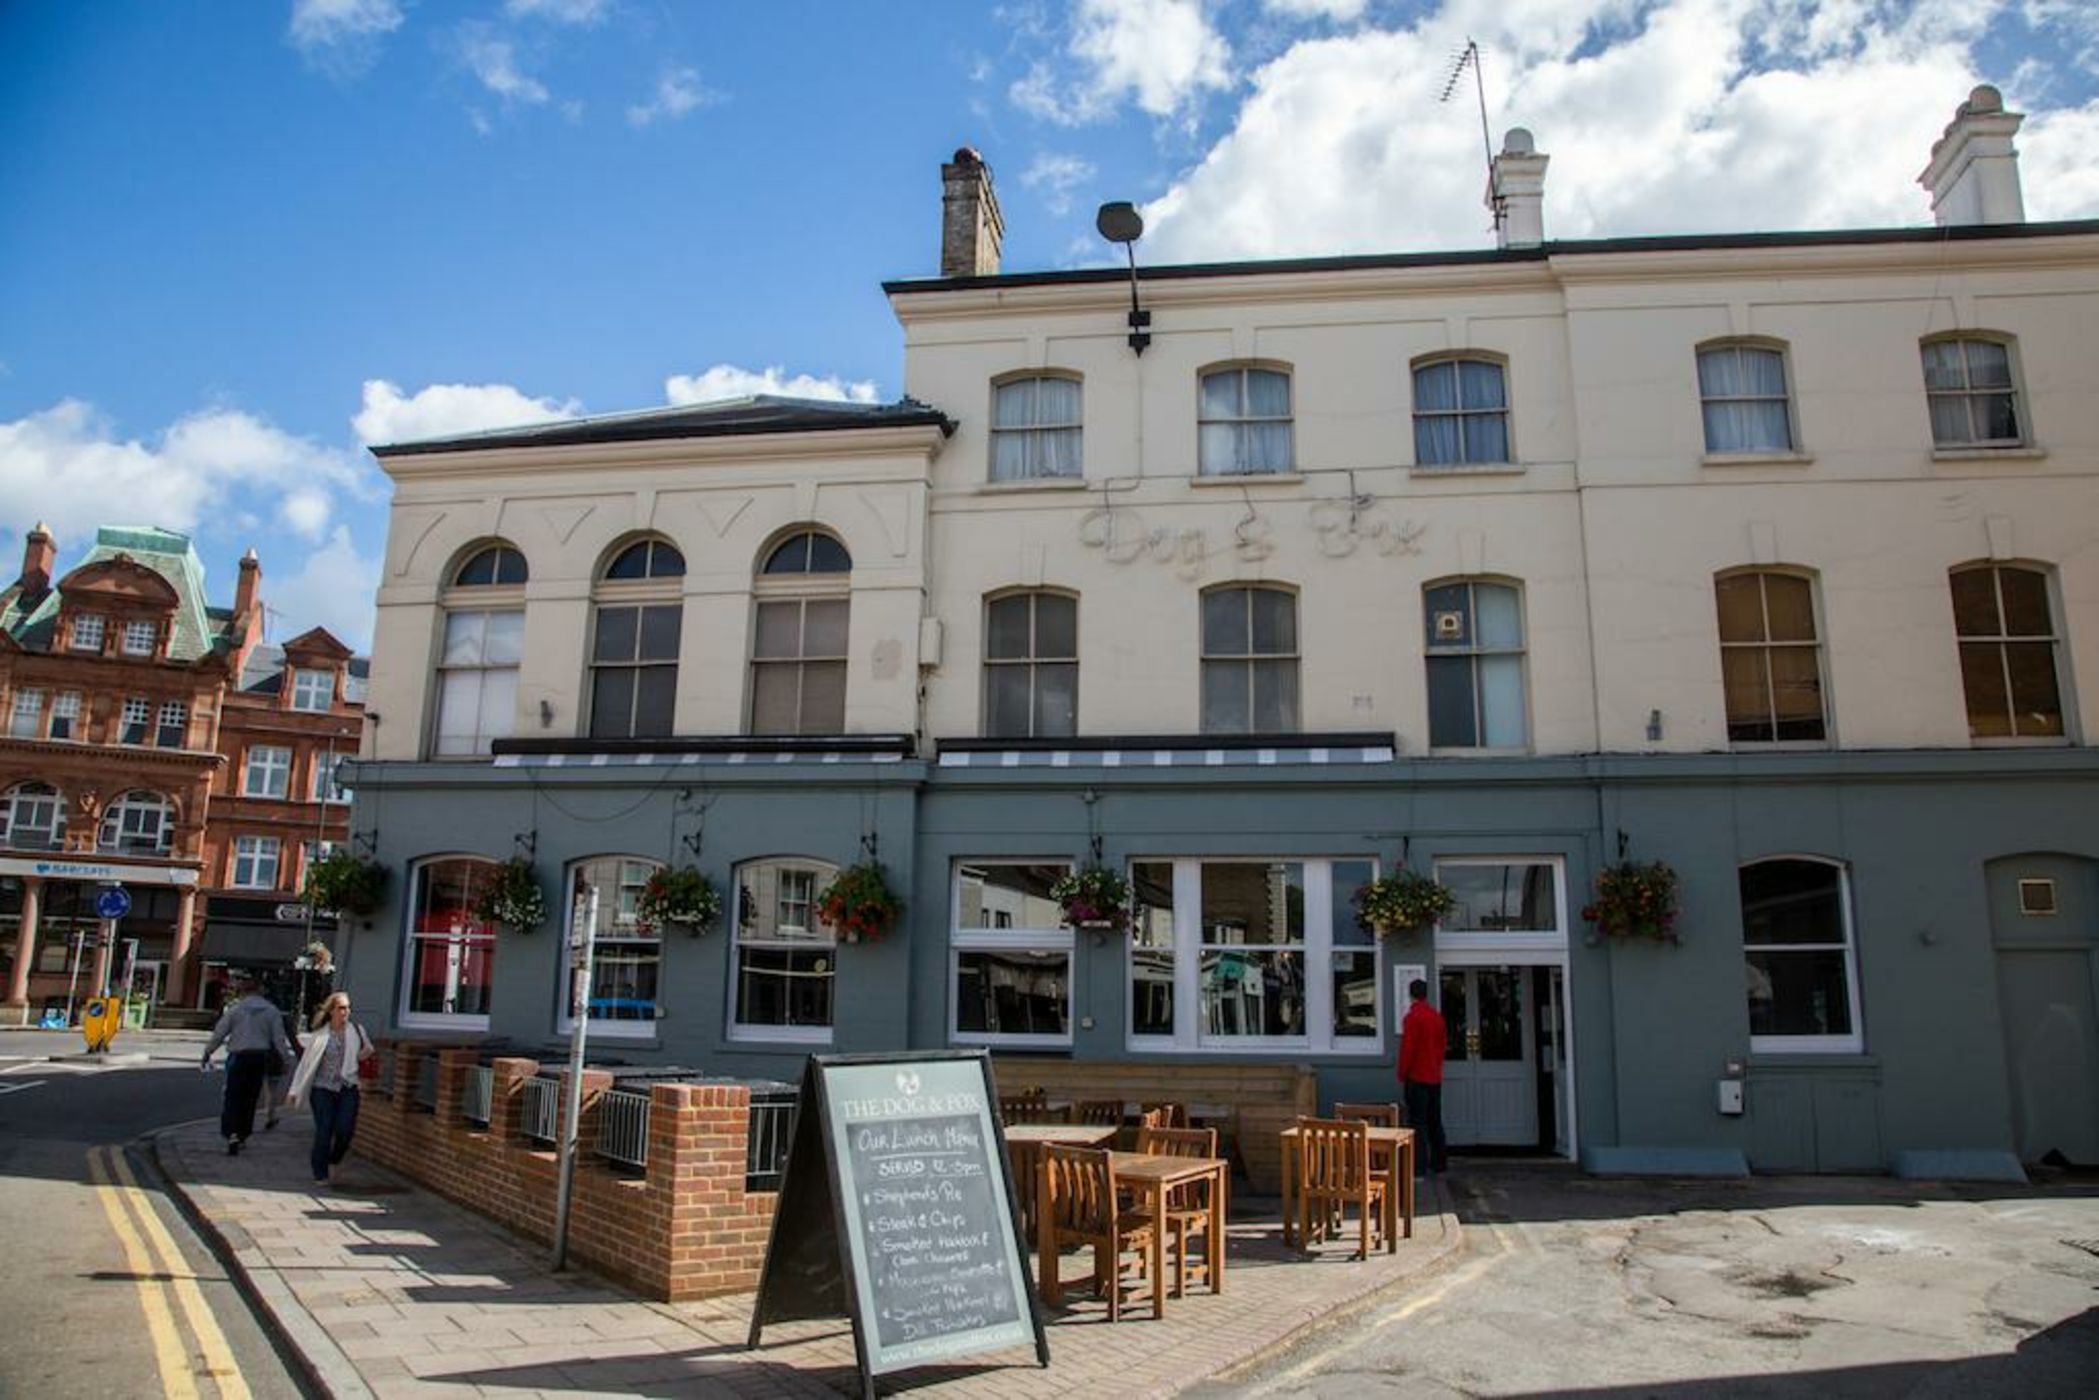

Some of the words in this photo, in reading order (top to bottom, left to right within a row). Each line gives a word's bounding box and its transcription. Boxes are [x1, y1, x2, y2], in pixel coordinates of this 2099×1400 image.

[844, 1098, 880, 1118] THE
[884, 1095, 926, 1116] DOG
[928, 1096, 944, 1113] &
[947, 1093, 982, 1112] FOX
[892, 1127, 940, 1149] Lunch
[939, 1181, 962, 1201] Pie
[878, 1215, 916, 1233] Steak
